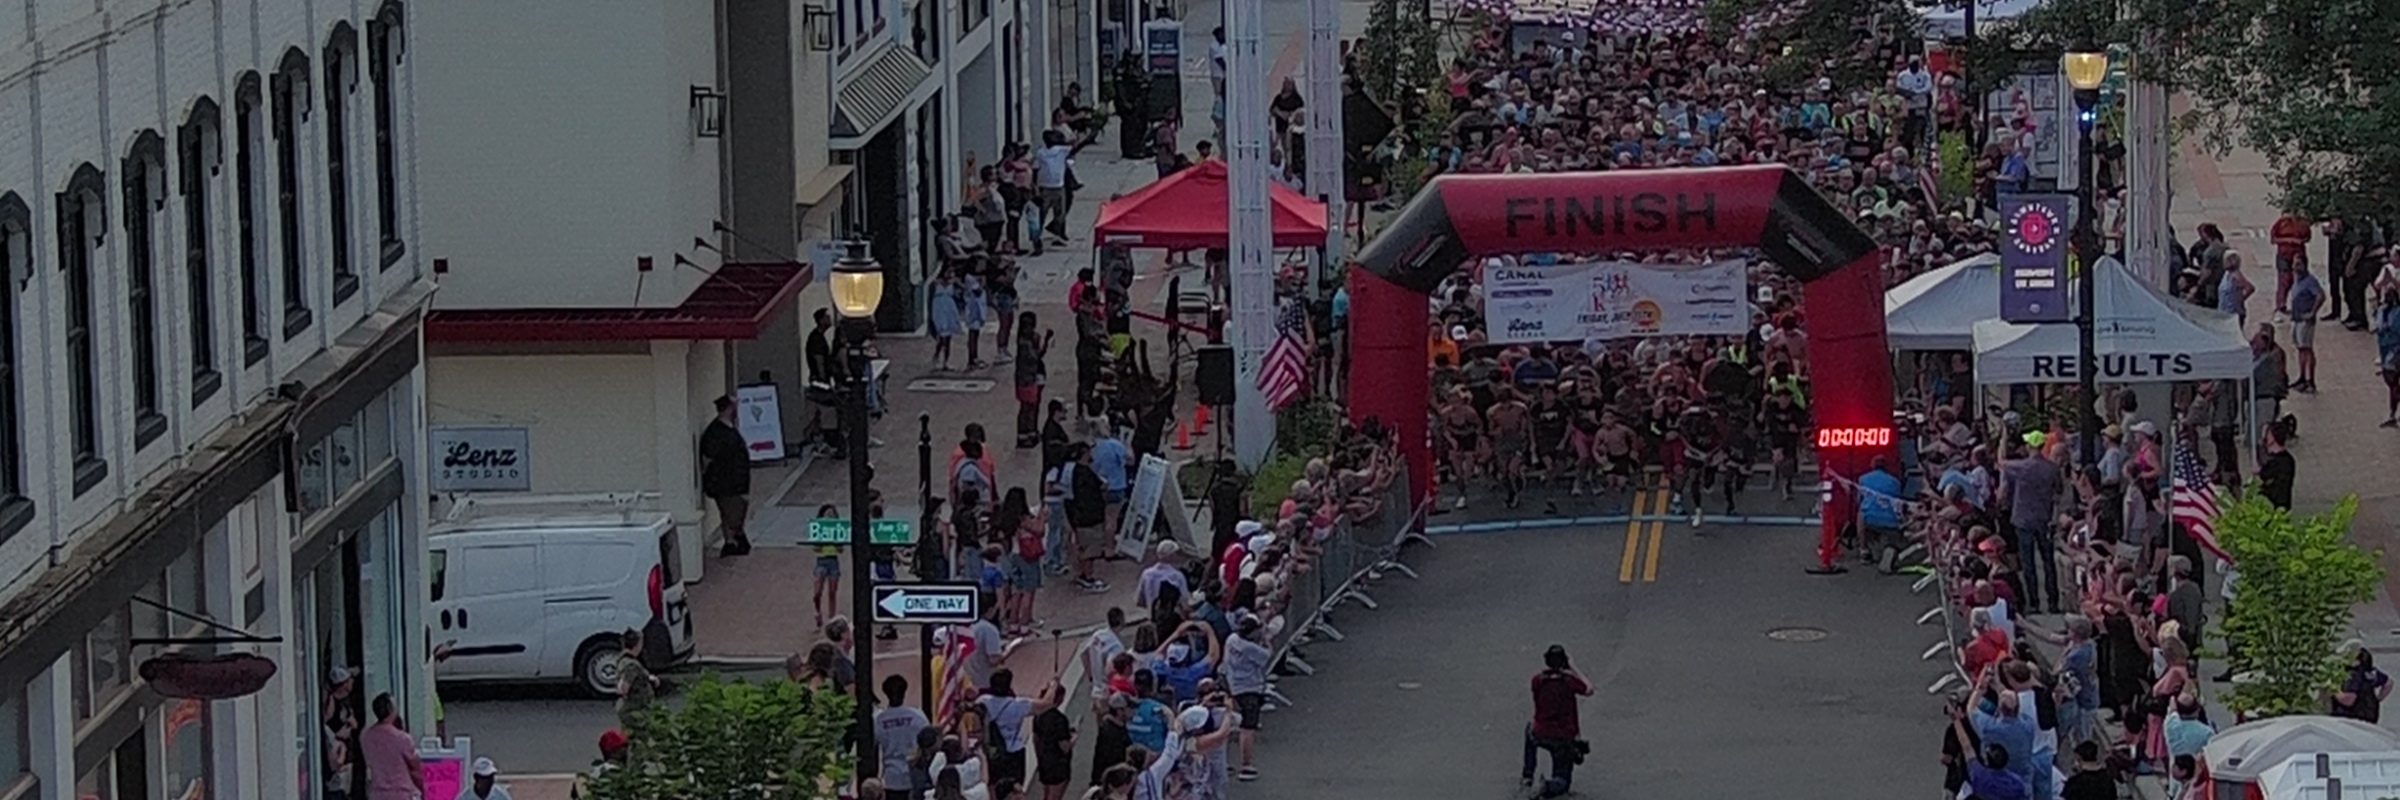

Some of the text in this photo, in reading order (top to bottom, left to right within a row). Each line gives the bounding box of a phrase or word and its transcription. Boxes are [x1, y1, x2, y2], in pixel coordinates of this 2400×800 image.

[1506, 192, 1716, 237] FINISH
[1494, 269, 1546, 281] CANAL
[2032, 353, 2194, 378] REULTS
[443, 440, 518, 468] Lenz
[443, 469, 519, 480] STUDIO
[904, 597, 965, 610] ONE WAY
